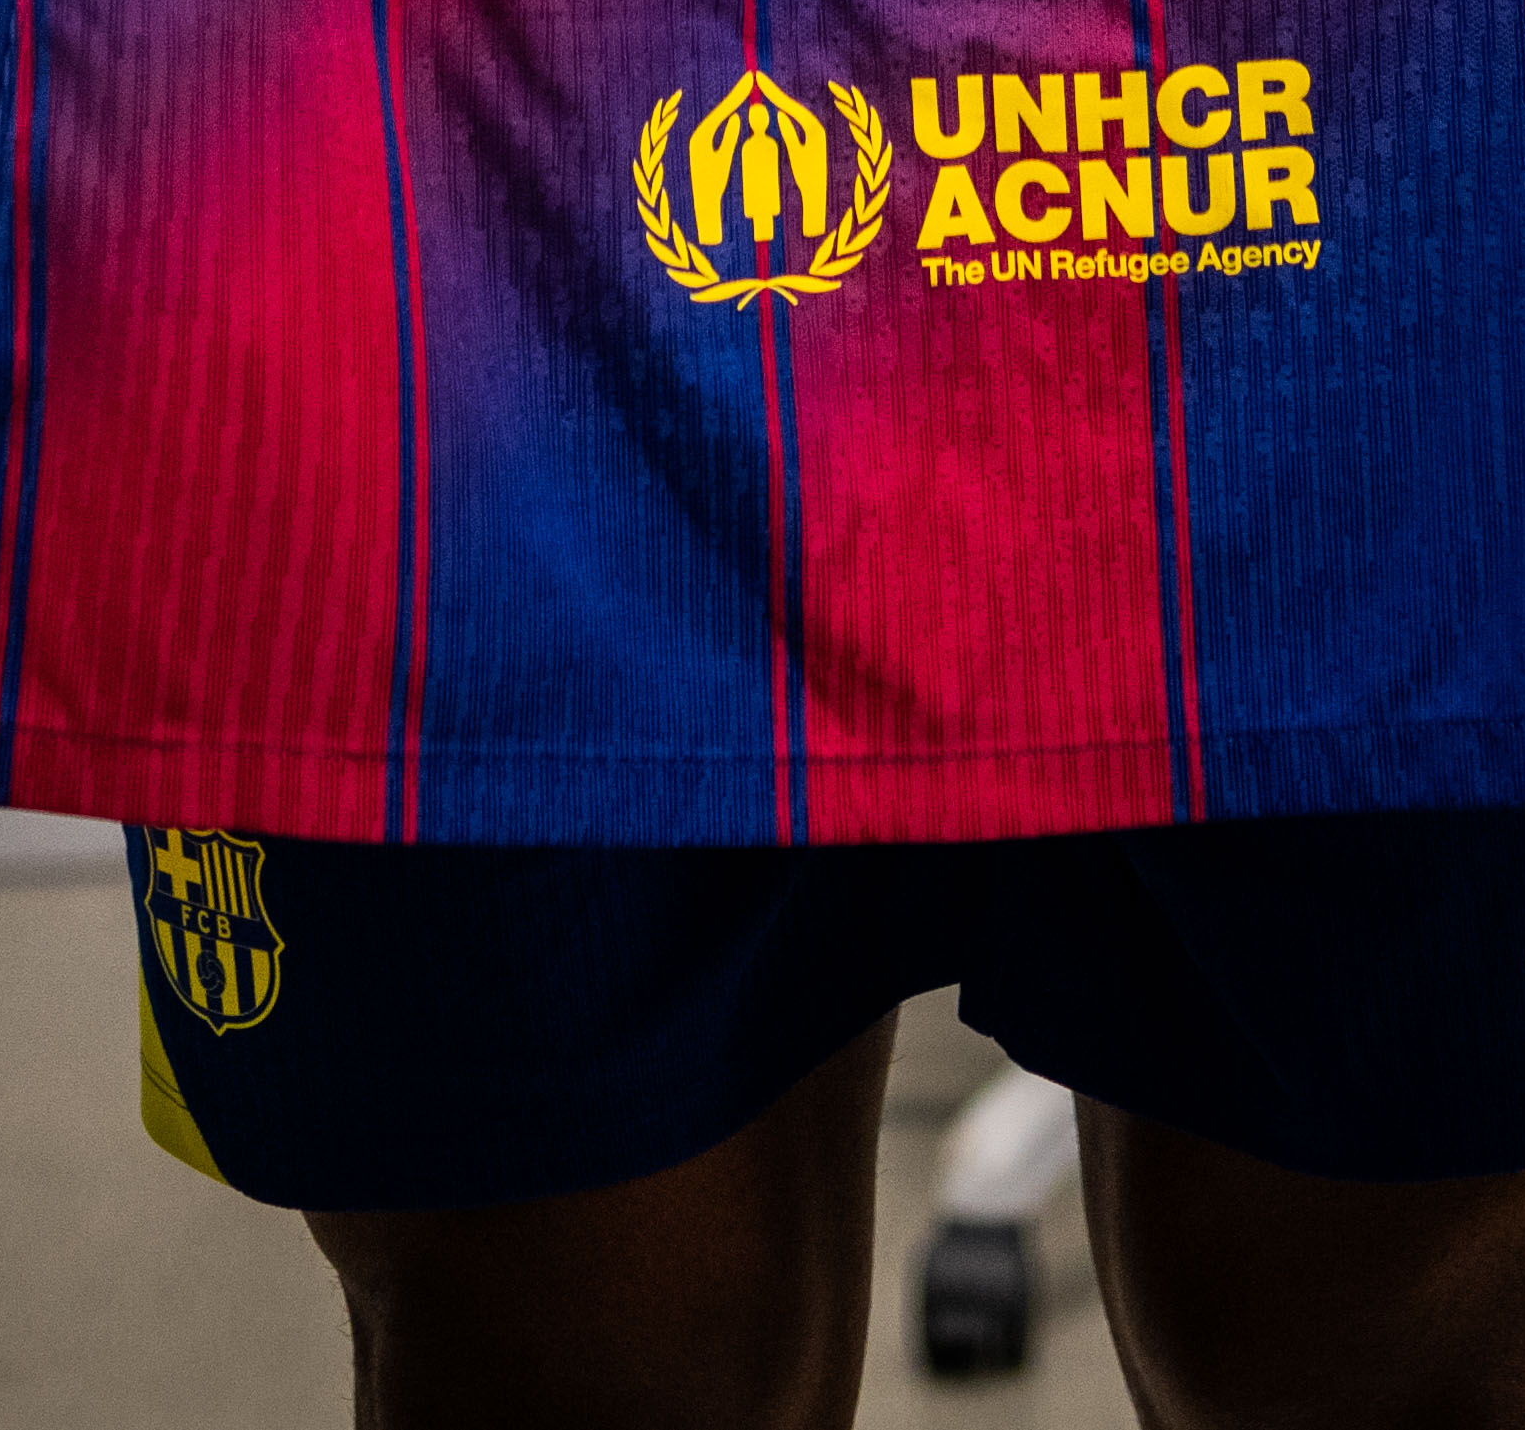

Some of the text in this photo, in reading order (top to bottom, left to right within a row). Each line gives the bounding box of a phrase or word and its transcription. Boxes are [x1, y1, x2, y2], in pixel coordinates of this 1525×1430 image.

[910, 58, 1315, 160] UNHCR
[916, 145, 1321, 250] ACNUR
[921, 239, 1323, 287] The UN Refugee Agency
[181, 904, 232, 939] FCB
